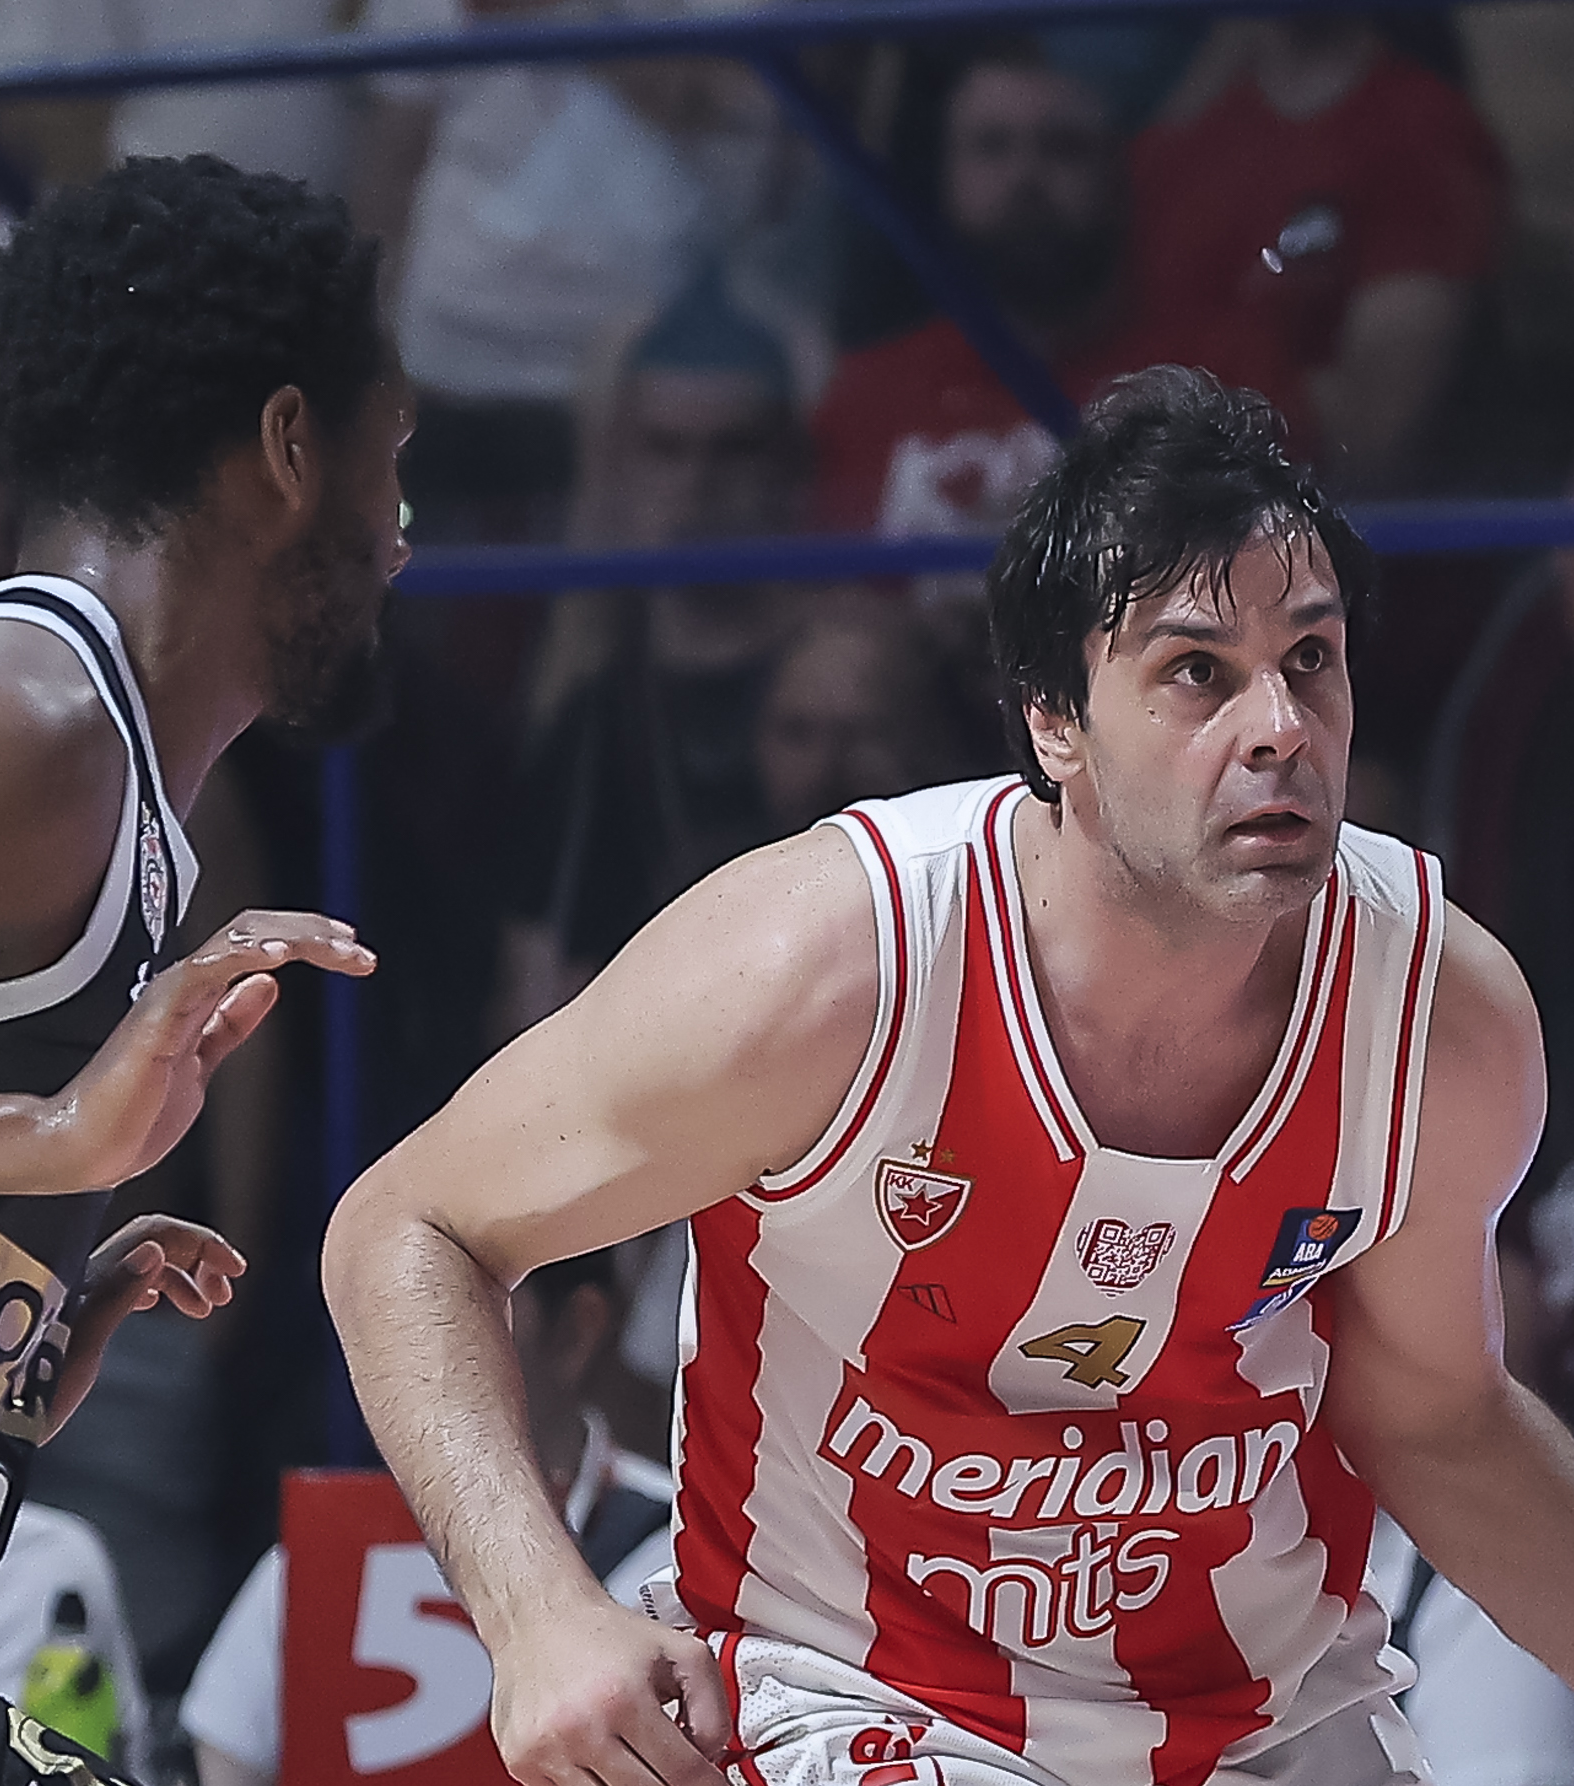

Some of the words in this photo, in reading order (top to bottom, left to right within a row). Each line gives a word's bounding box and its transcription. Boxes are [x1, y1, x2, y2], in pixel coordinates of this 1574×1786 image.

[1292, 1242, 1325, 1262] ABA
[1017, 1314, 1147, 1390] 4
[828, 1395, 1300, 1518] meridian
[906, 1527, 1181, 1641] mts
[344, 1543, 493, 1775] 5
